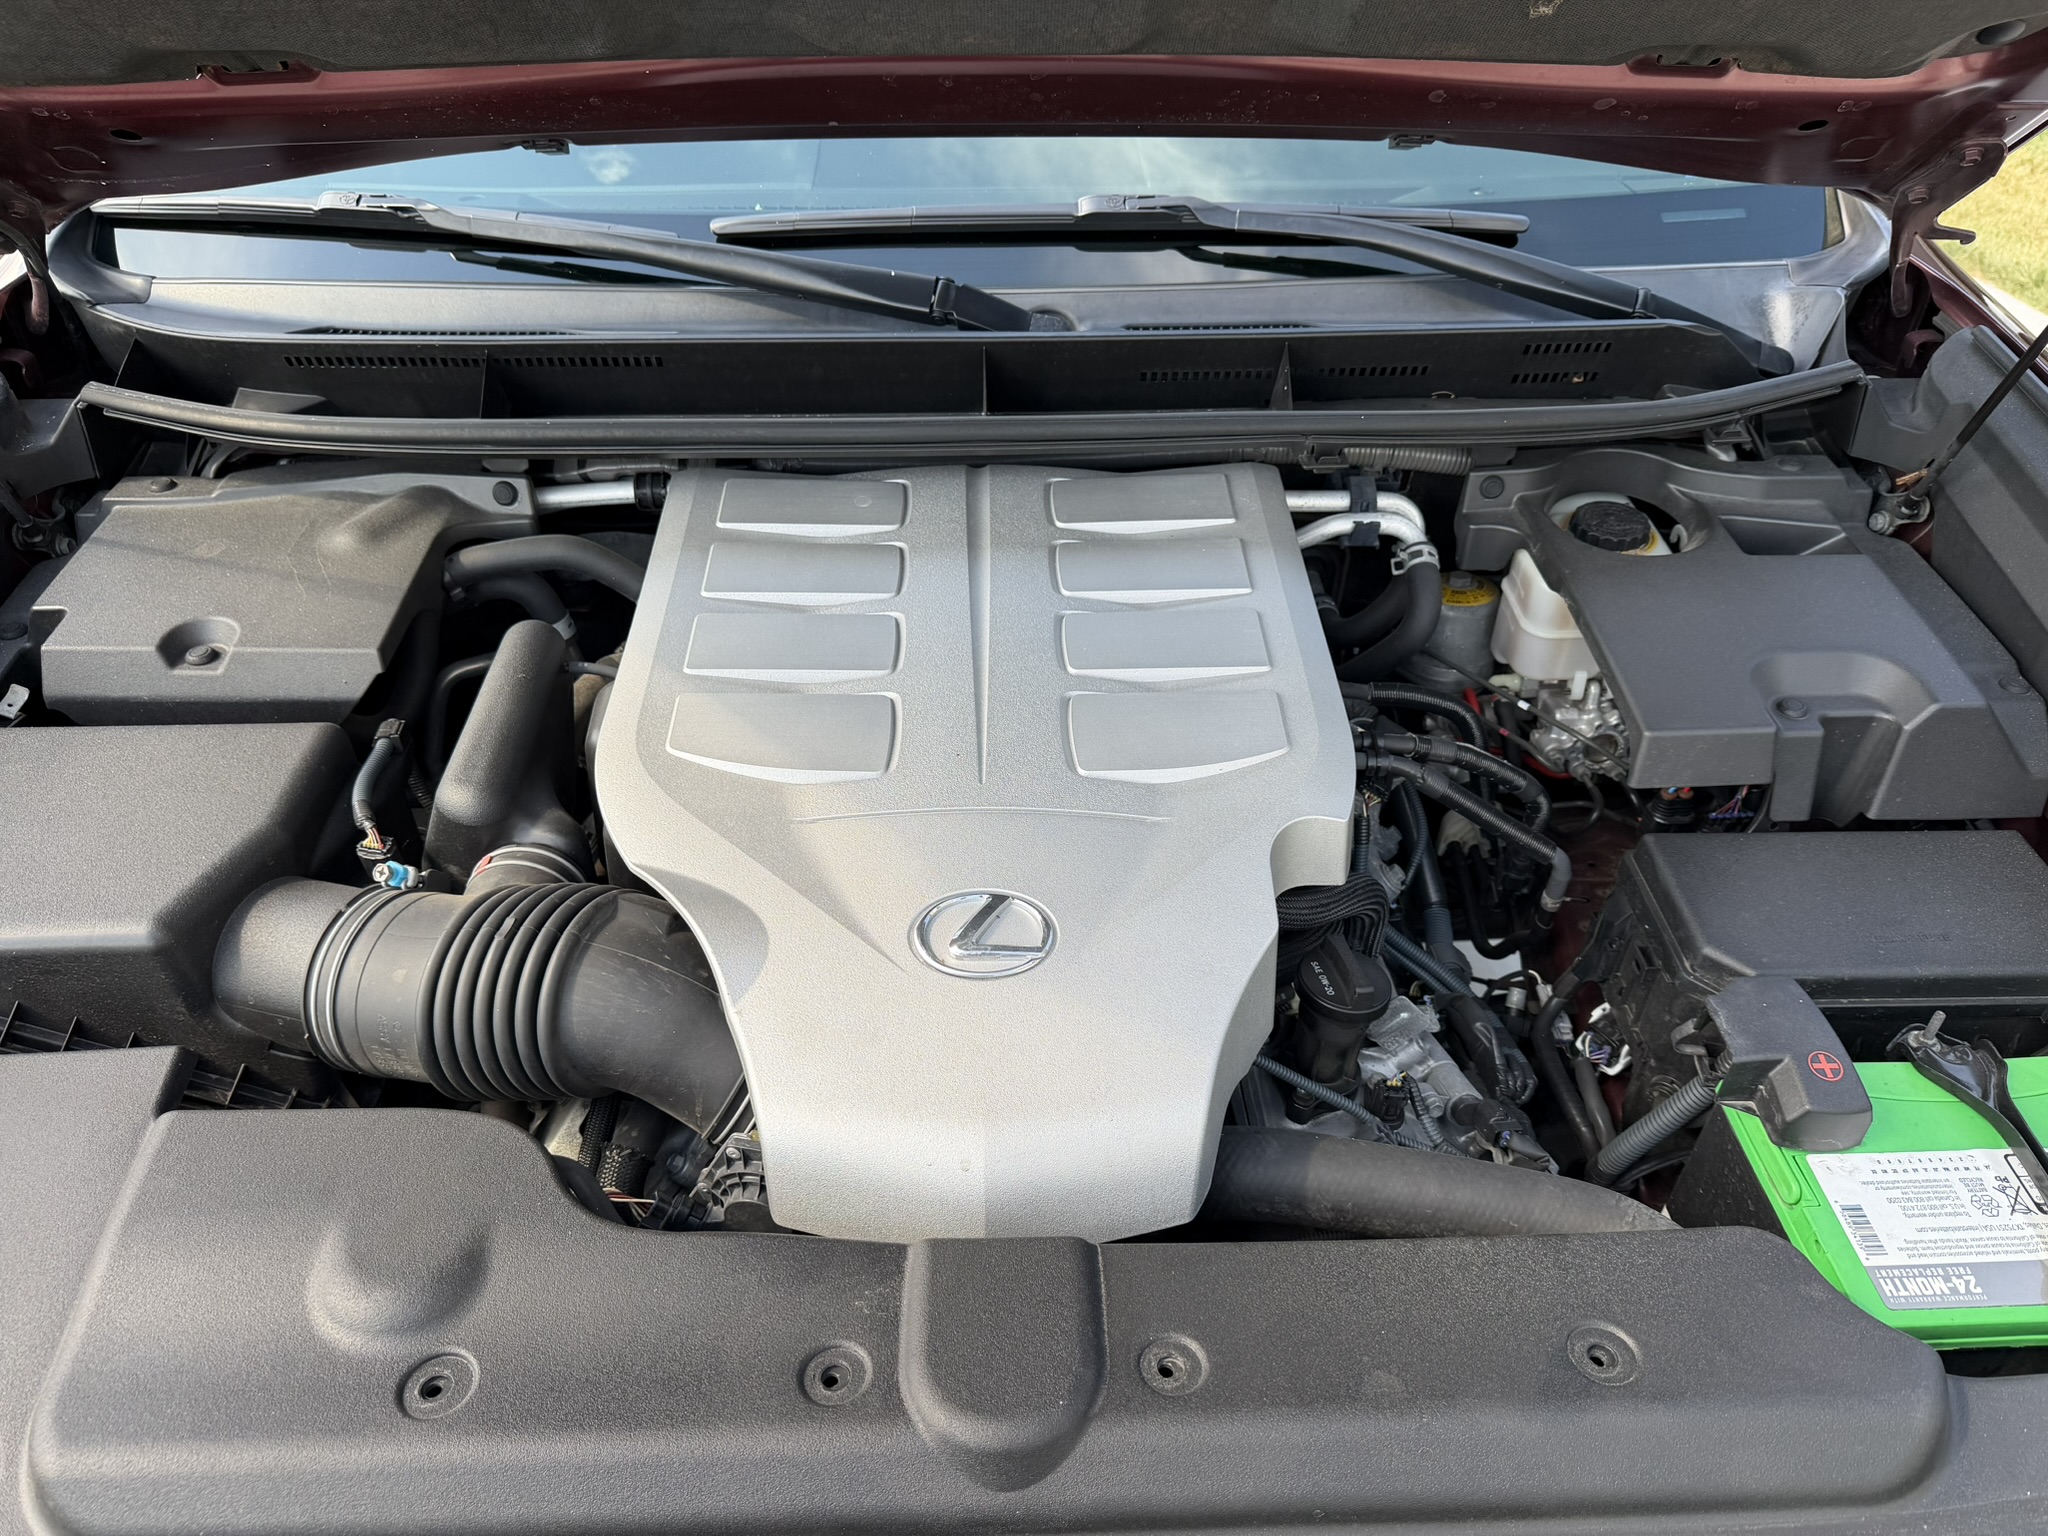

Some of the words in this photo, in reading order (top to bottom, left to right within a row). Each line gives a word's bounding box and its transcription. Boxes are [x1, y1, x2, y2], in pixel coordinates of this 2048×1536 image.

[1311, 961, 1324, 973] SAE
[1319, 975, 1335, 995] 0W-20
[1943, 1210, 1964, 1218] replace
[1874, 1268, 1944, 1277] REPLACEMENT
[1878, 1275, 1984, 1296] 24-MONTH
